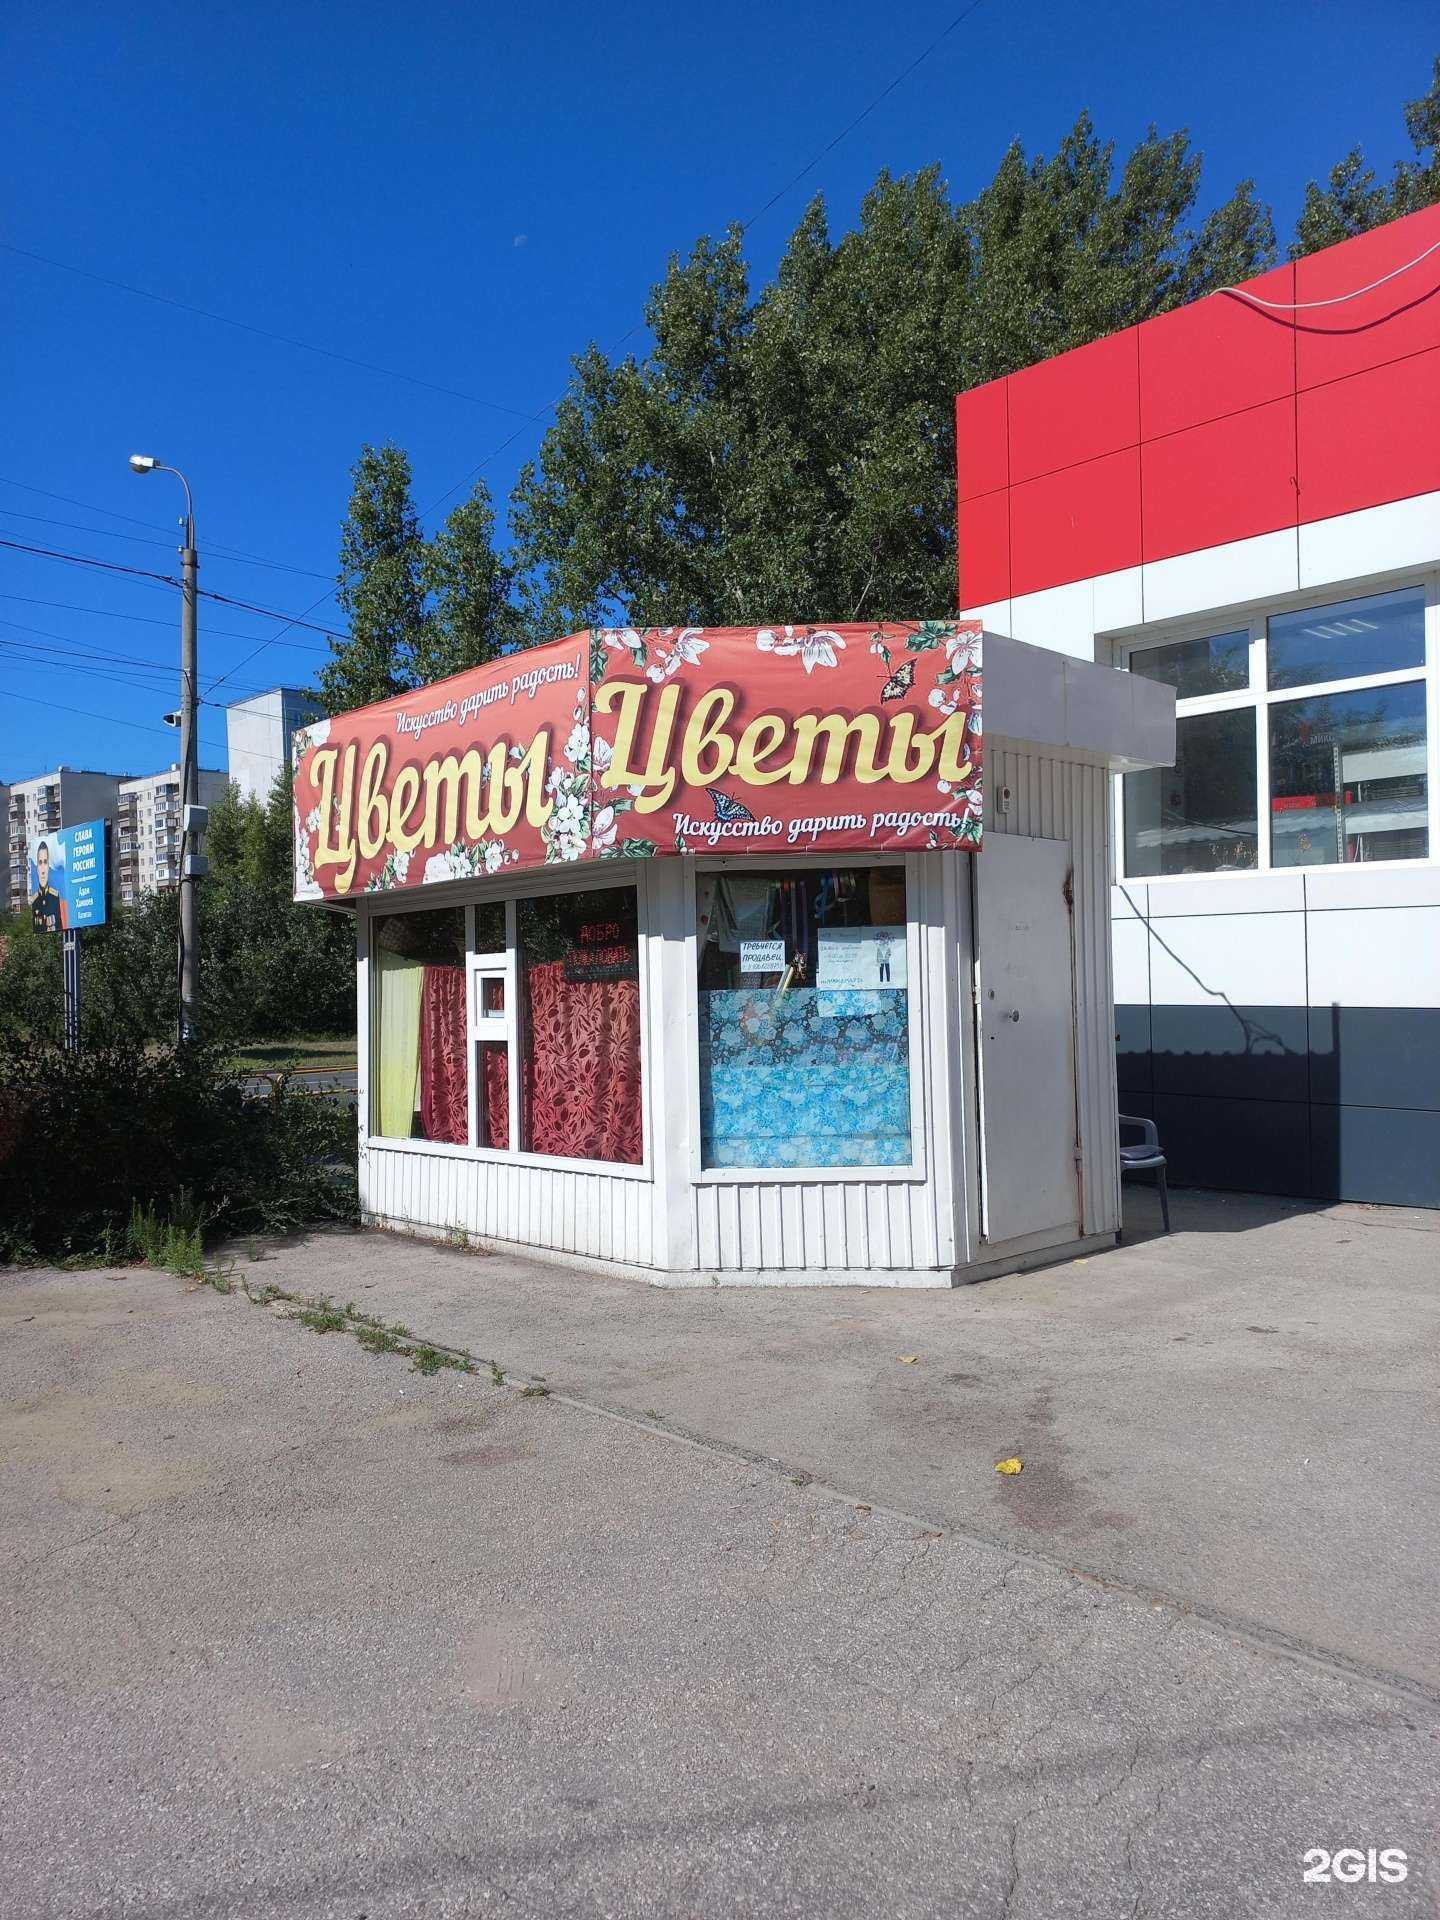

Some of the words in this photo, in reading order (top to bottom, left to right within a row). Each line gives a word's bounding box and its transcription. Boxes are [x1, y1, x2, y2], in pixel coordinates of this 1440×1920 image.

[396, 700, 457, 740] Искусство
[459, 680, 508, 725] дарить
[511, 653, 581, 704] радость!
[595, 681, 972, 814] Цветы
[309, 731, 553, 894] Цветы
[74, 829, 93, 843] СЛАВА
[672, 813, 782, 845] Искусство
[787, 814, 866, 843] дарить
[869, 808, 969, 838] радость!
[73, 843, 95, 858] ГЕРОЯМ
[72, 857, 96, 873] РОССИИ!
[743, 942, 783, 951] ТРЕБУЕТСЯ
